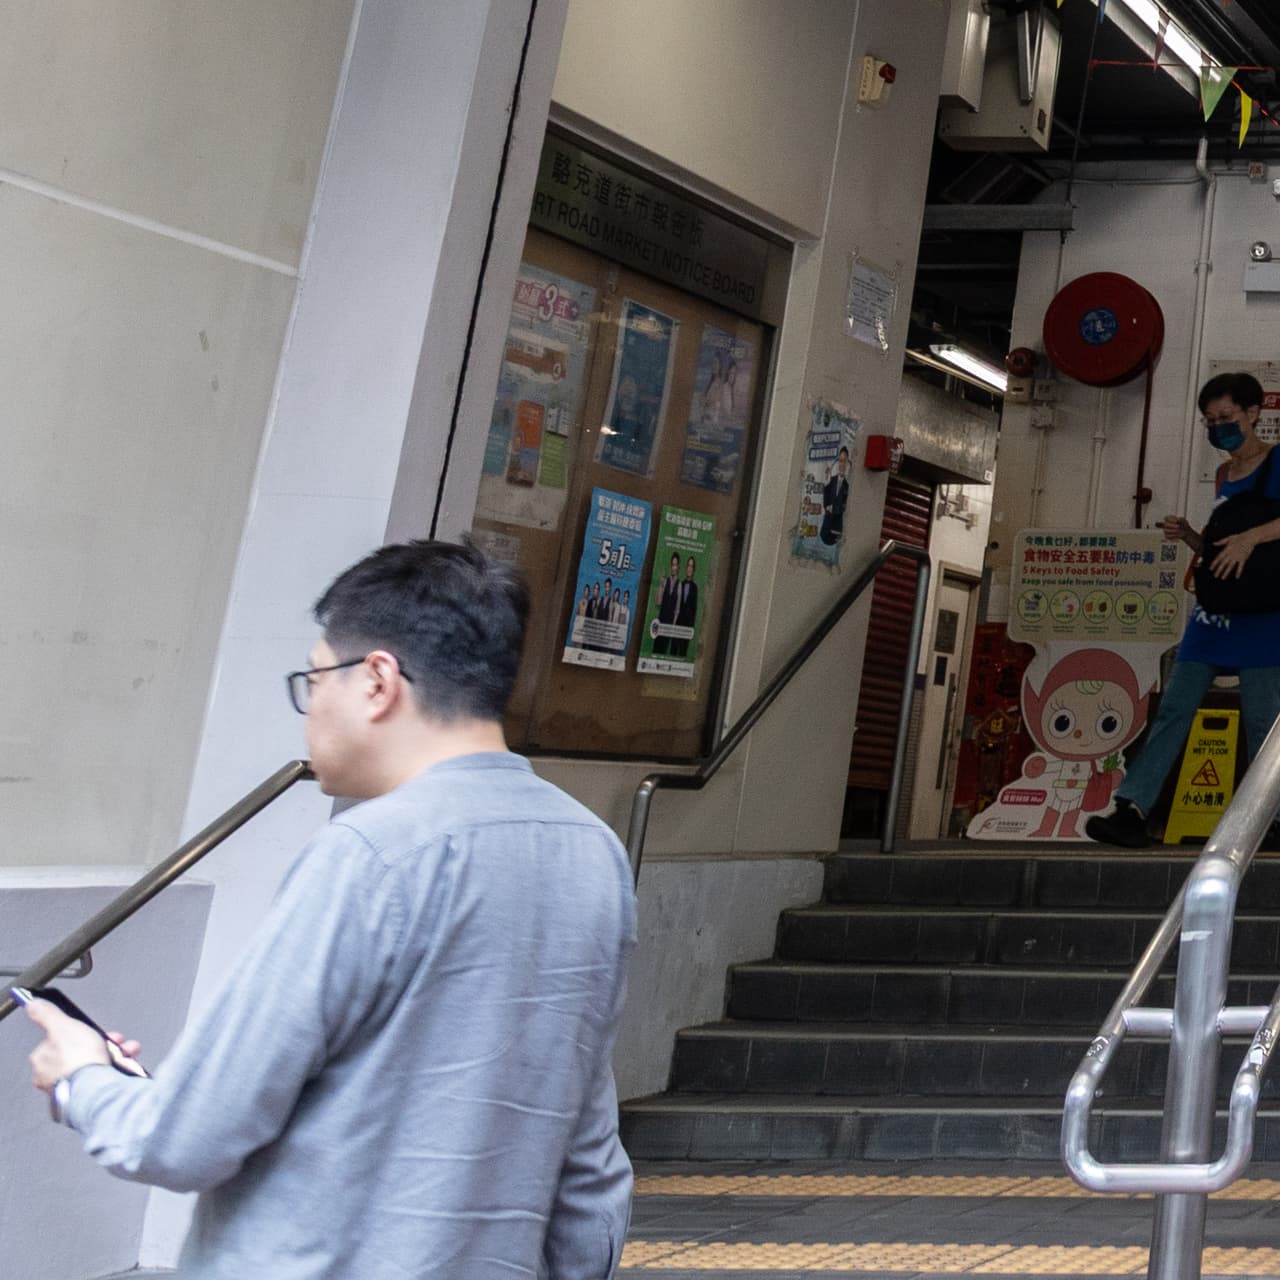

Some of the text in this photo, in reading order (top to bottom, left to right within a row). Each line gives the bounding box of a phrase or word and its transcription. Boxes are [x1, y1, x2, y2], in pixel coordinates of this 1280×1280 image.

[558, 199, 599, 239] ROAD
[601, 220, 665, 263] MARKET
[663, 249, 712, 287] NOTICE
[711, 270, 756, 305] BOARD
[1022, 567, 1121, 578] 5 Keys to Food Safety
[1182, 791, 1226, 807] 小心地滑
